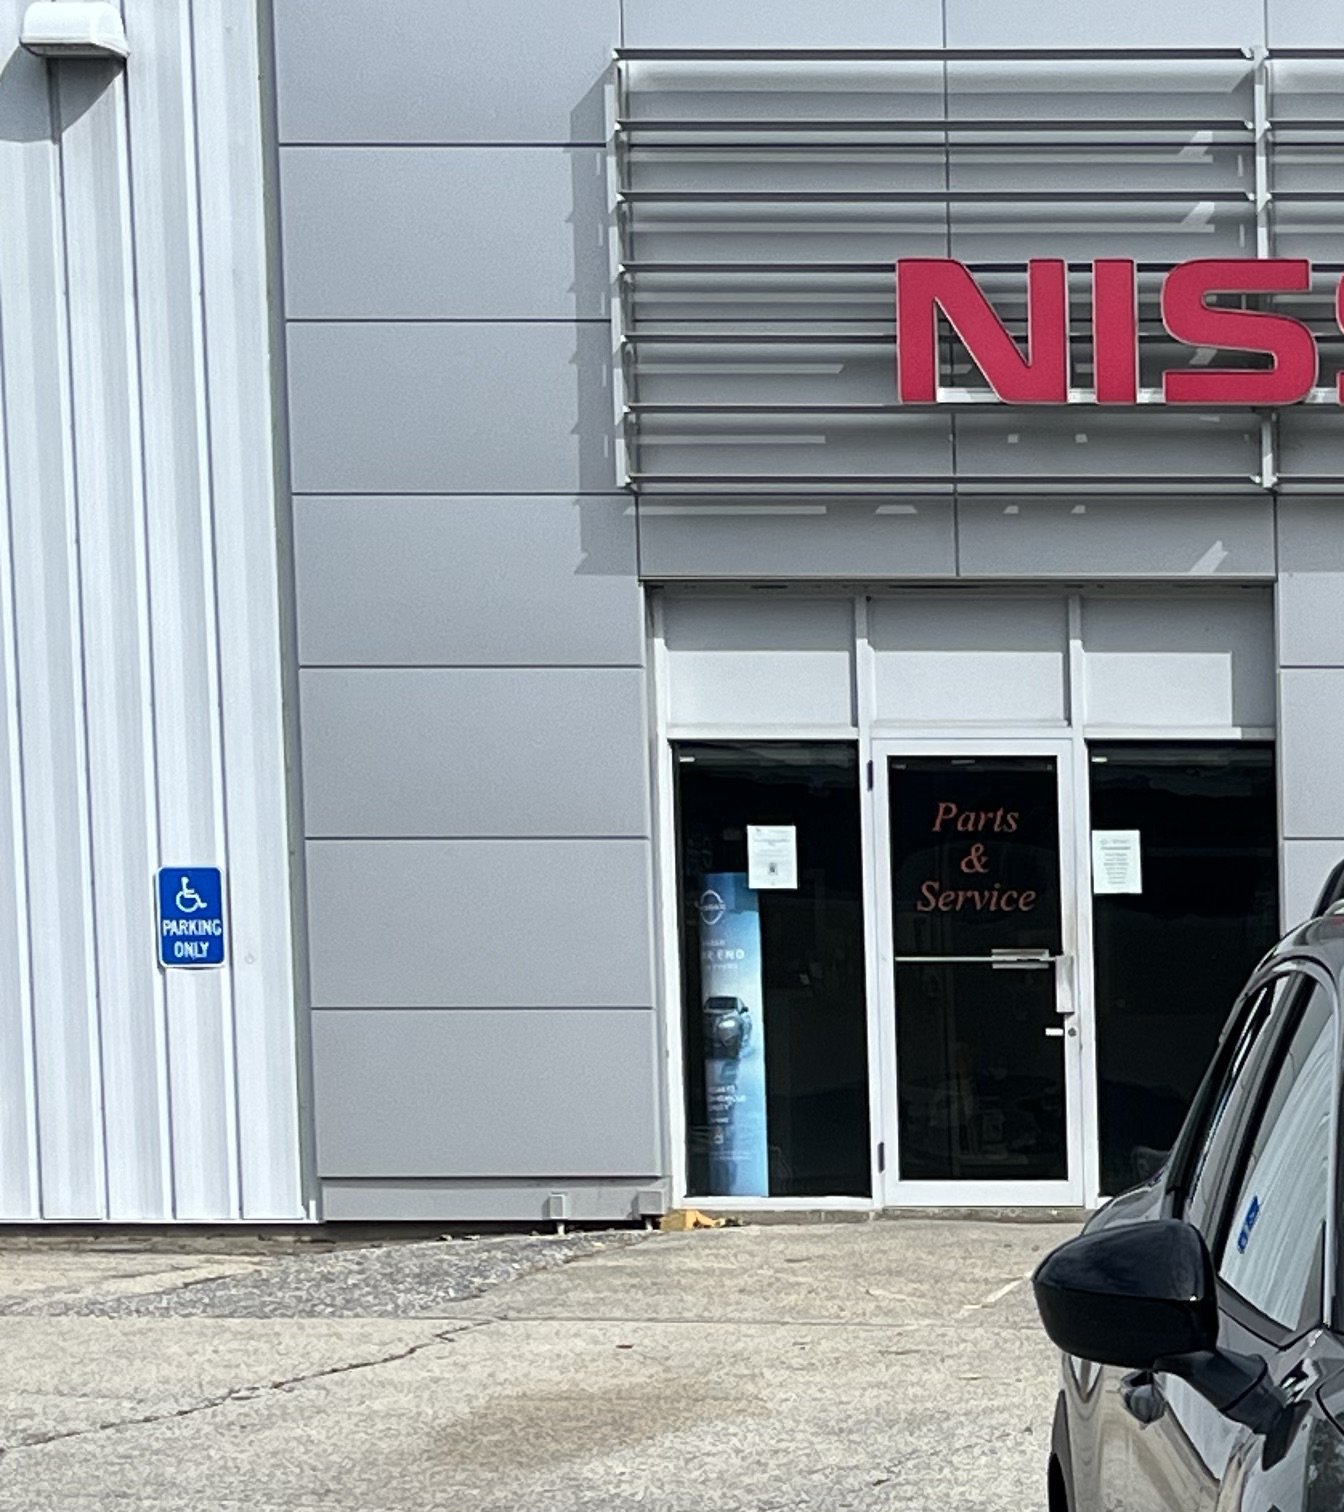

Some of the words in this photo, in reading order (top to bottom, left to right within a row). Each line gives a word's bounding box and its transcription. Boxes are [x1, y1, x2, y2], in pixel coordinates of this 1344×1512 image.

[932, 802, 1020, 832] Parts
[960, 842, 989, 874] &
[916, 880, 1037, 912] Service
[162, 919, 222, 936] PARKING
[174, 941, 209, 958] ONLY
